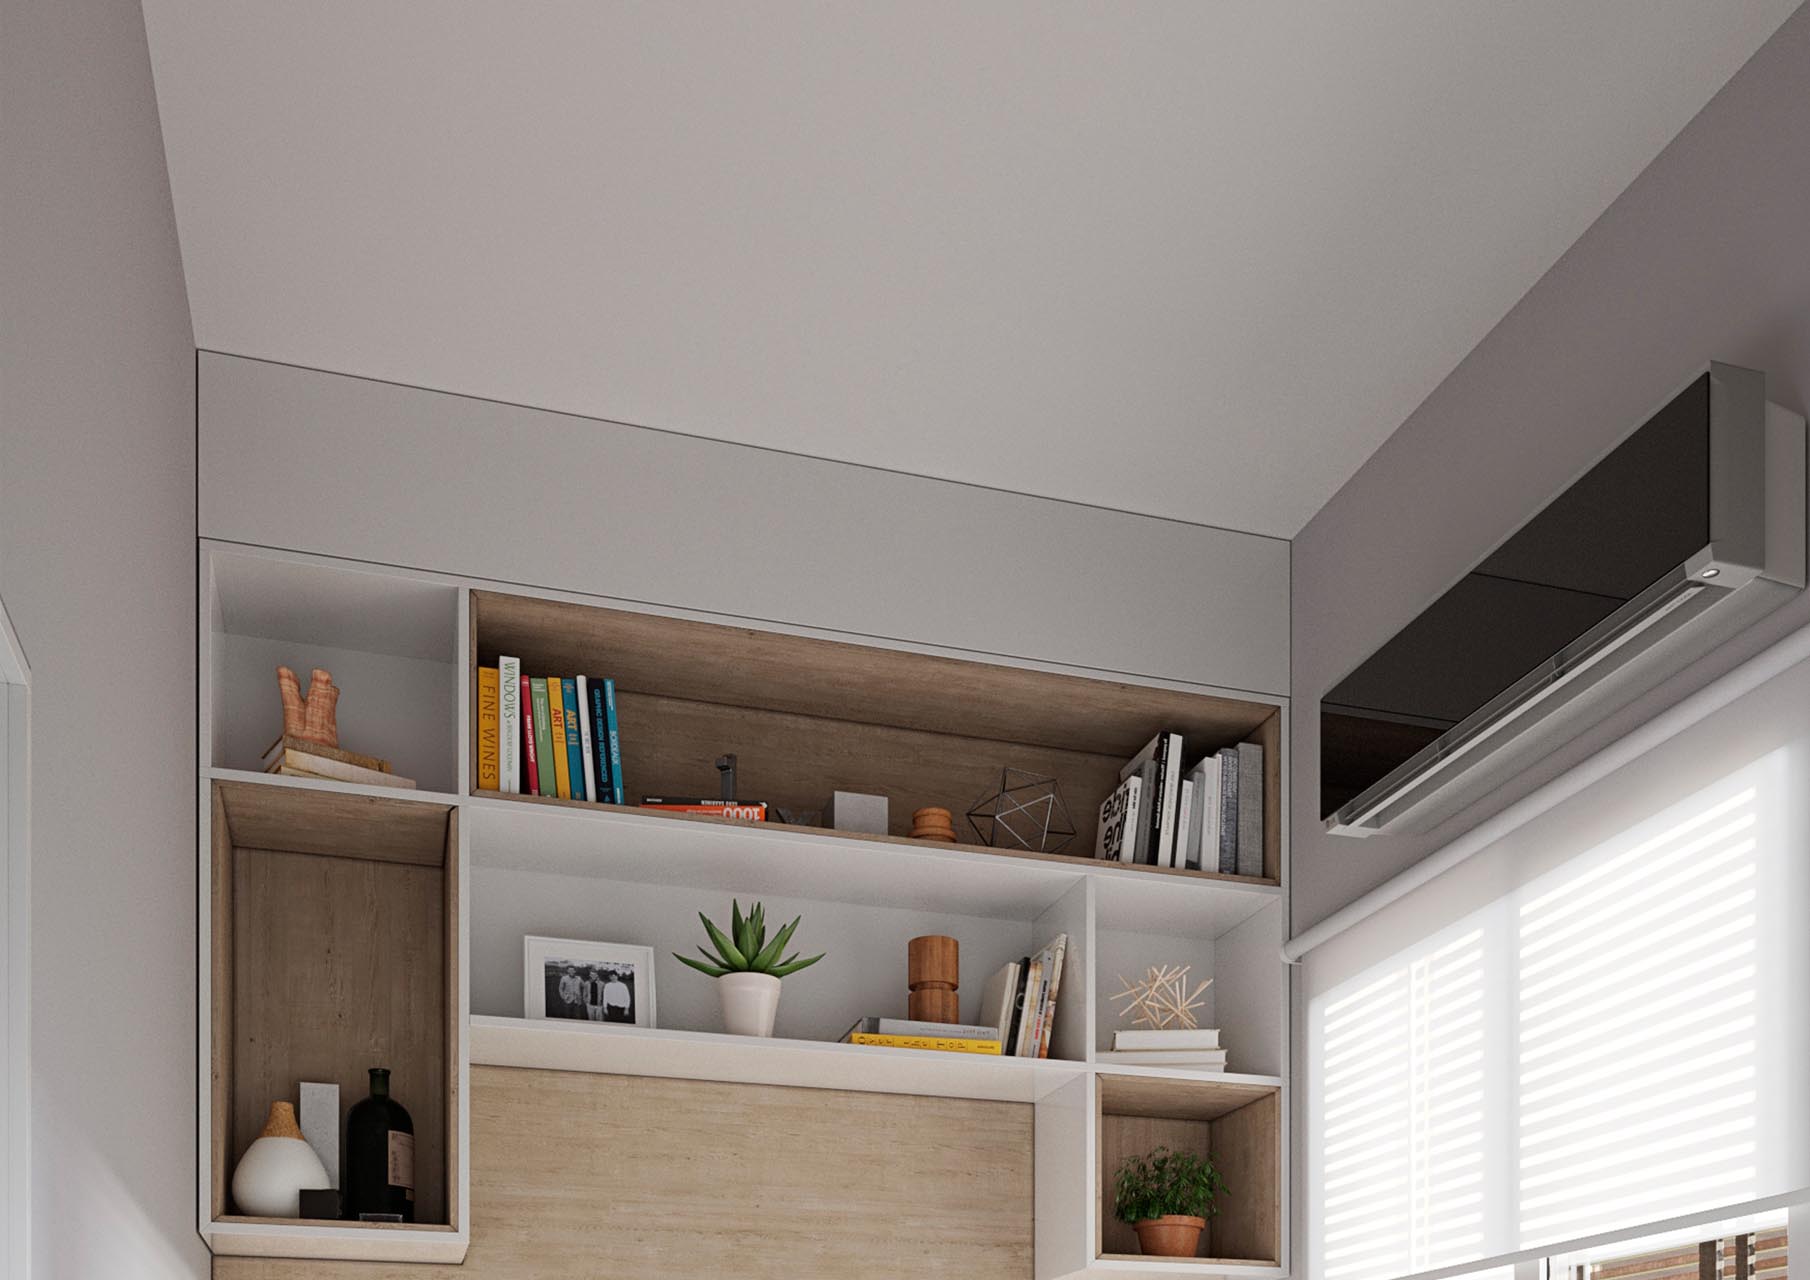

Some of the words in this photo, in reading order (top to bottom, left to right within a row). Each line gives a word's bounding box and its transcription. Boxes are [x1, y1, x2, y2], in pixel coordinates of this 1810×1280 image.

[482, 685, 496, 721] FINE
[503, 661, 517, 720] WINDOWS
[552, 707, 563, 729] ART
[566, 708, 578, 731] ART
[482, 728, 496, 781] WINES
[722, 807, 761, 821] 1000
